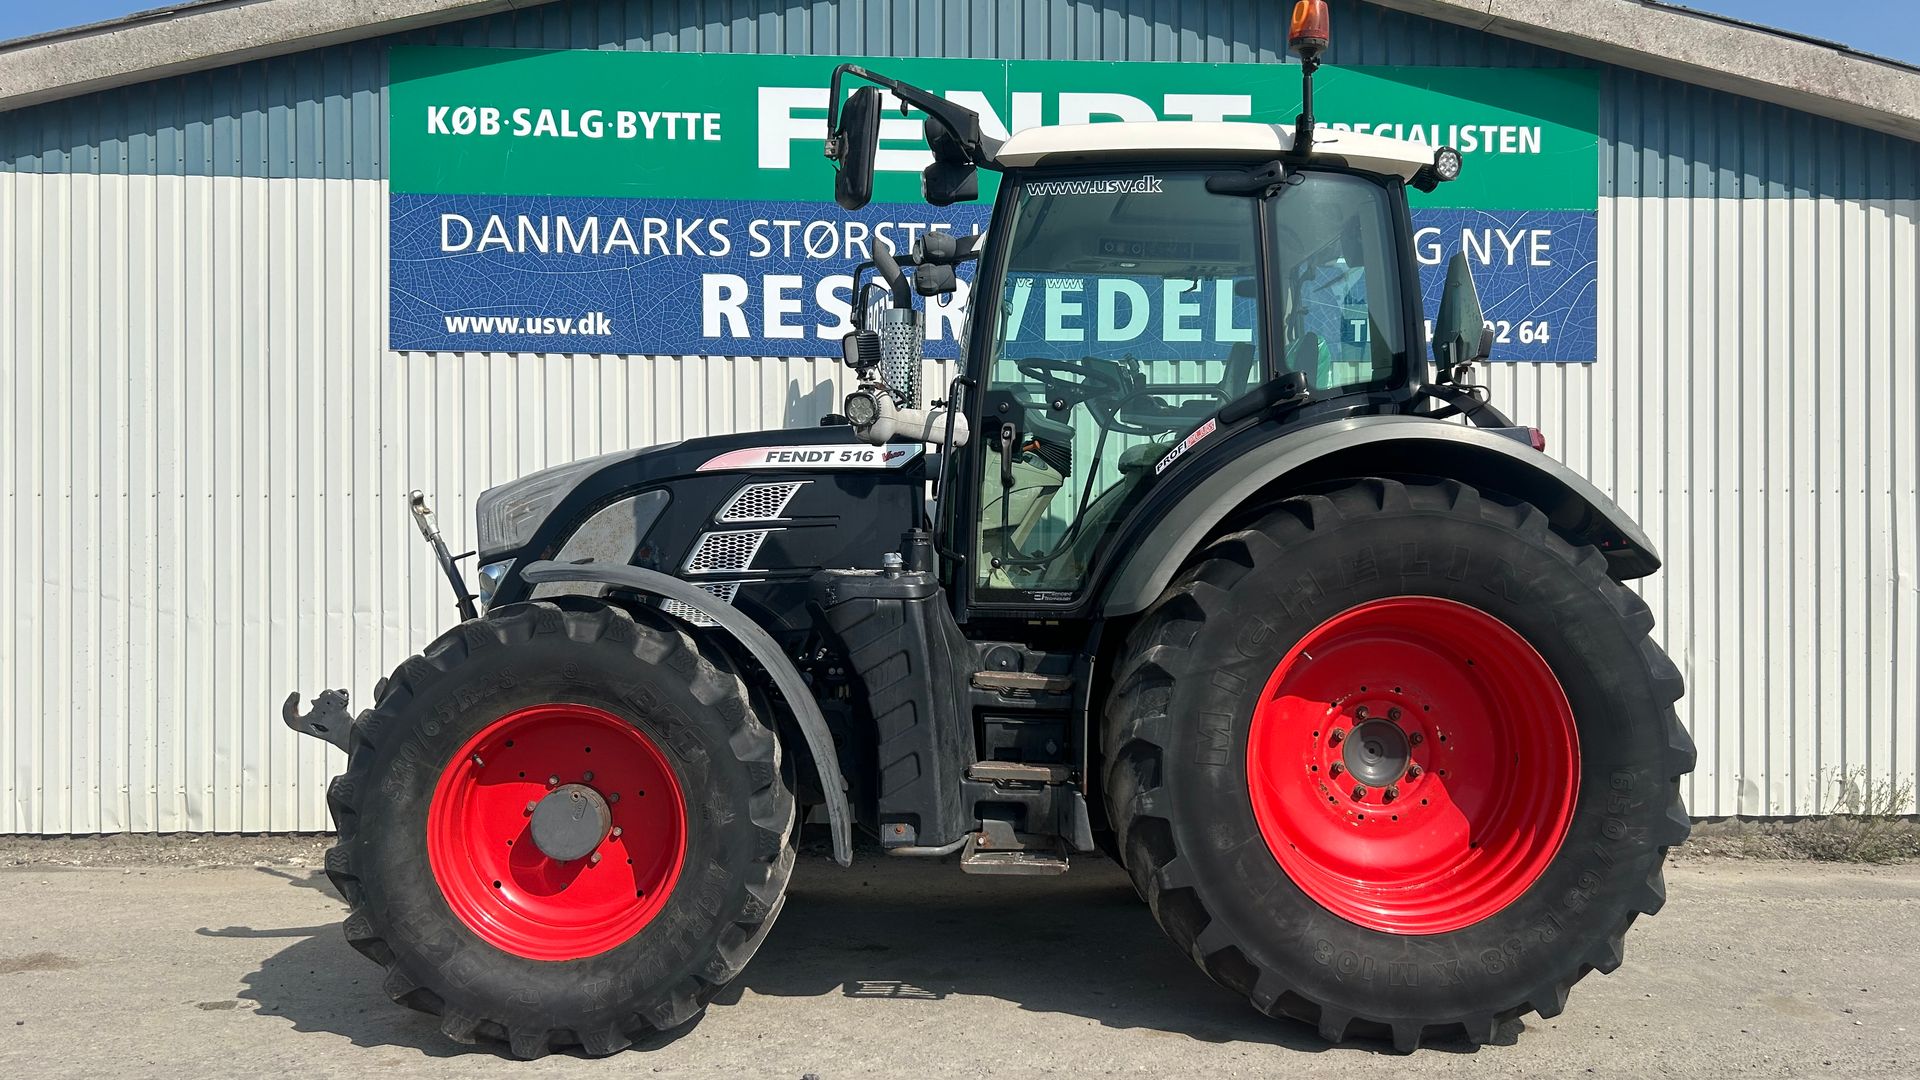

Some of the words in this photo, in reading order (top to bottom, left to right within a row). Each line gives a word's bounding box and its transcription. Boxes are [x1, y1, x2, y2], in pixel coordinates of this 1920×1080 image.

[1026, 175, 1163, 196] www.usv.dk
[440, 213, 732, 257] DANMARKS
[749, 219, 951, 259] STØRST
[1462, 228, 1551, 266] NYE
[445, 312, 611, 336] www.usv.dk
[1519, 321, 1550, 344] 64
[765, 450, 835, 463] FENDT
[839, 450, 874, 462] 516
